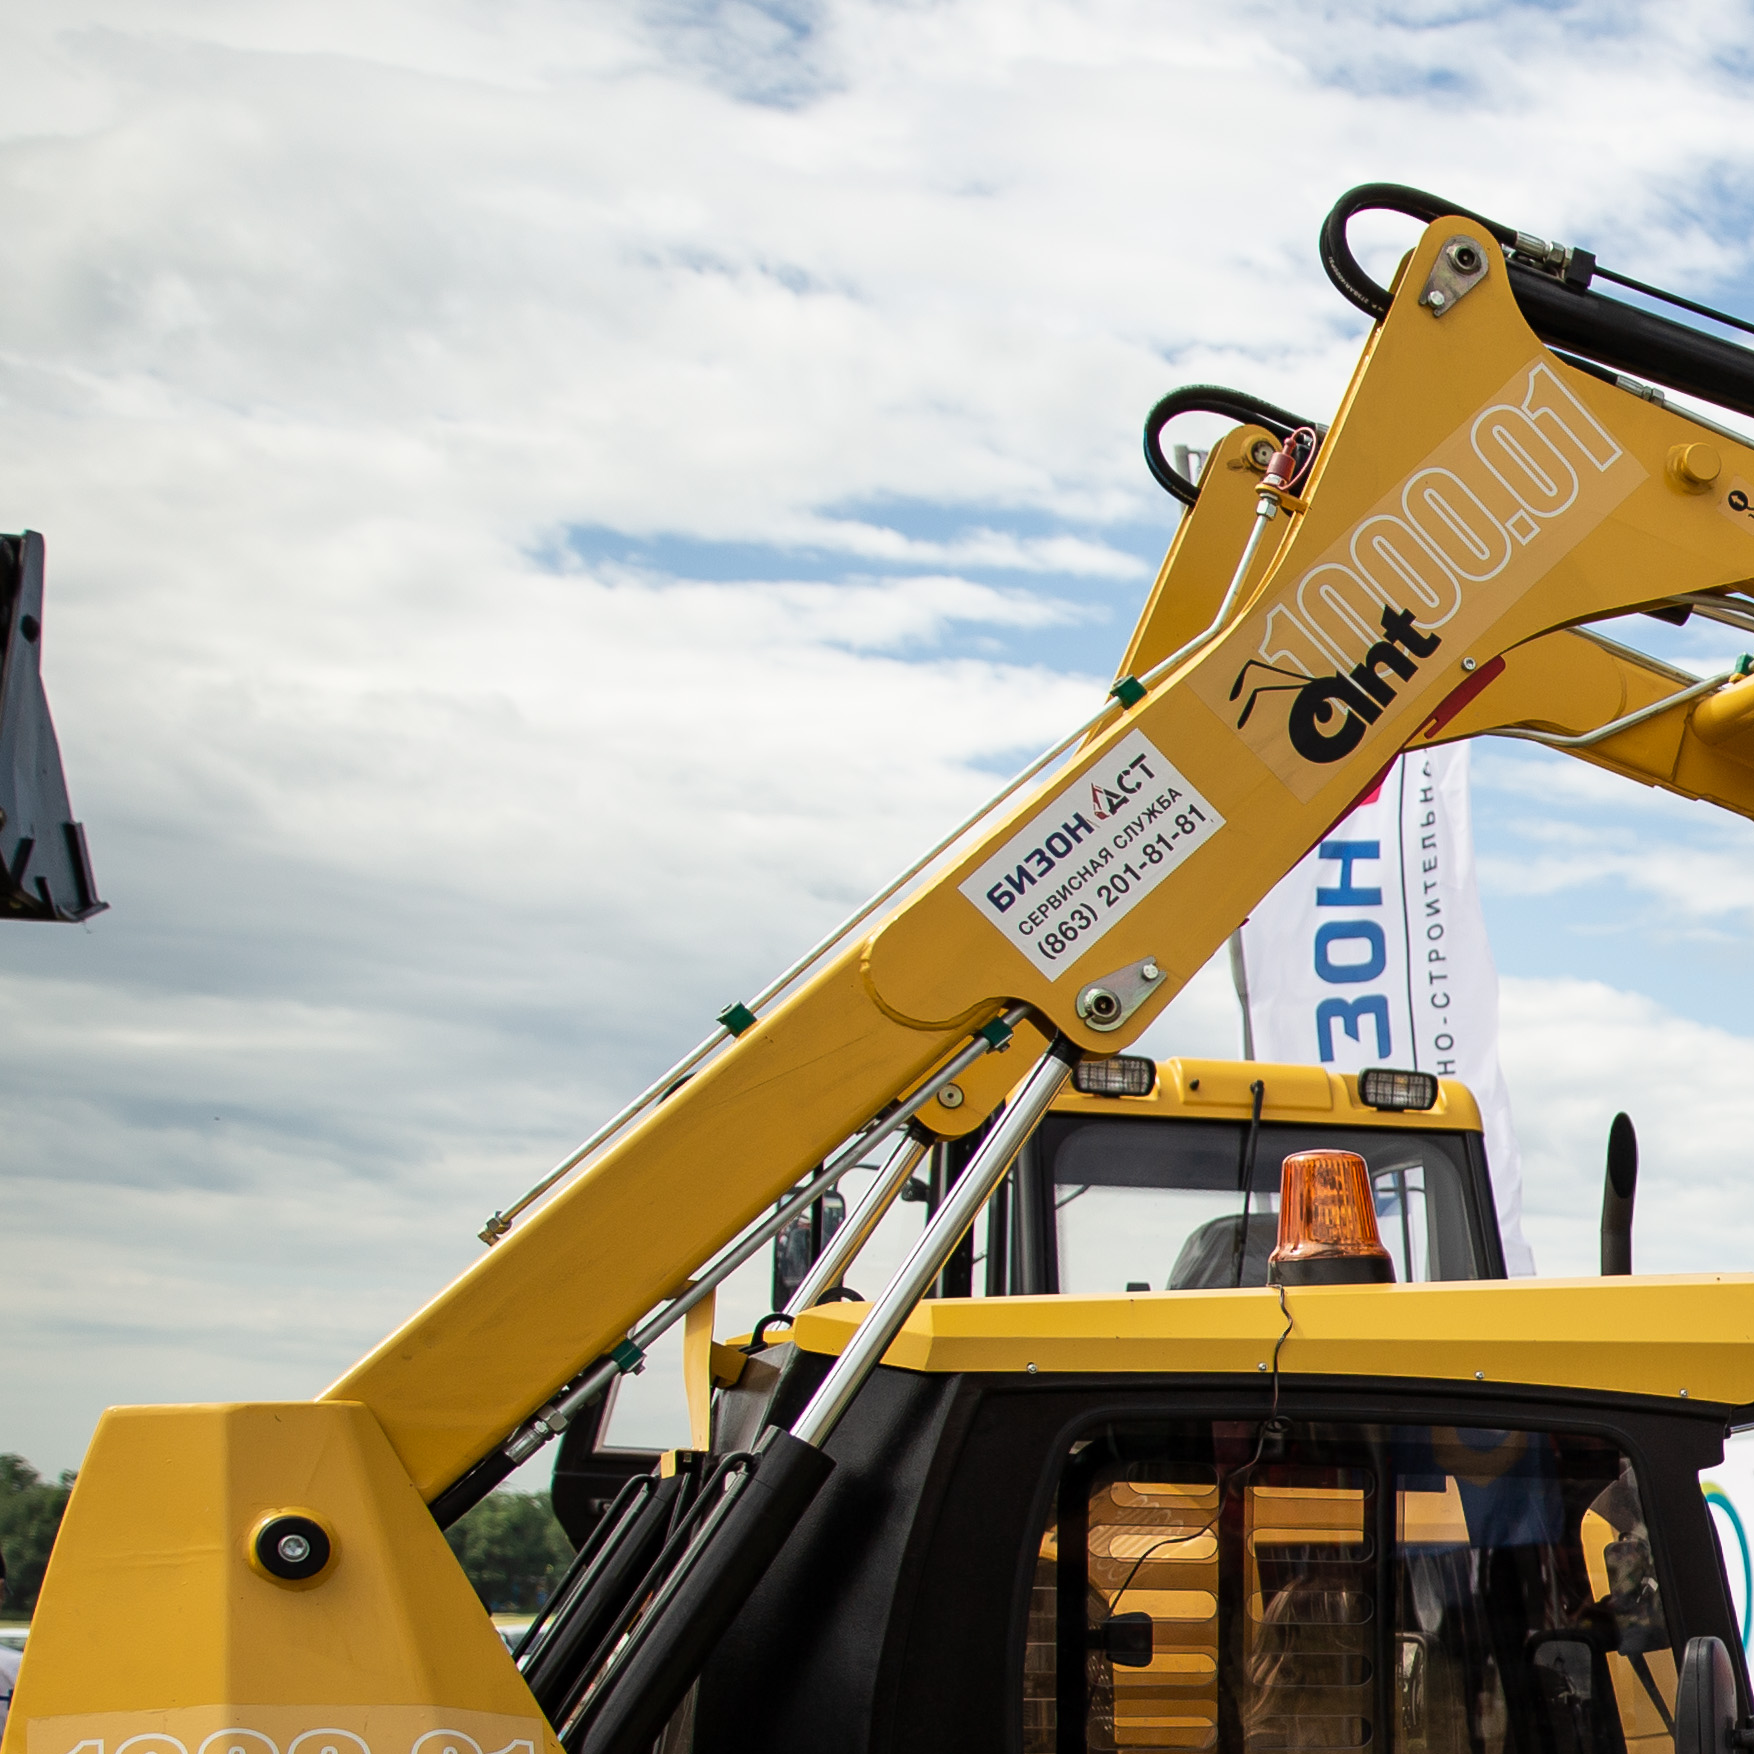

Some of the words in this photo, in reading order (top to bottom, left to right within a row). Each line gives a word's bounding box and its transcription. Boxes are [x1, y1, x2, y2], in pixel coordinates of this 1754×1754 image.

[1258, 361, 1623, 716] 1000.01
[1289, 604, 1441, 763] ant
[986, 812, 1095, 913] БИЗОН
[1018, 847, 1114, 936] СЕРВИСНАЯ
[1113, 787, 1183, 850] СЛУЖБА
[1037, 902, 1098, 960] (863)
[1096, 804, 1206, 908] 201-81-81
[1314, 839, 1392, 1063] ЗОН
